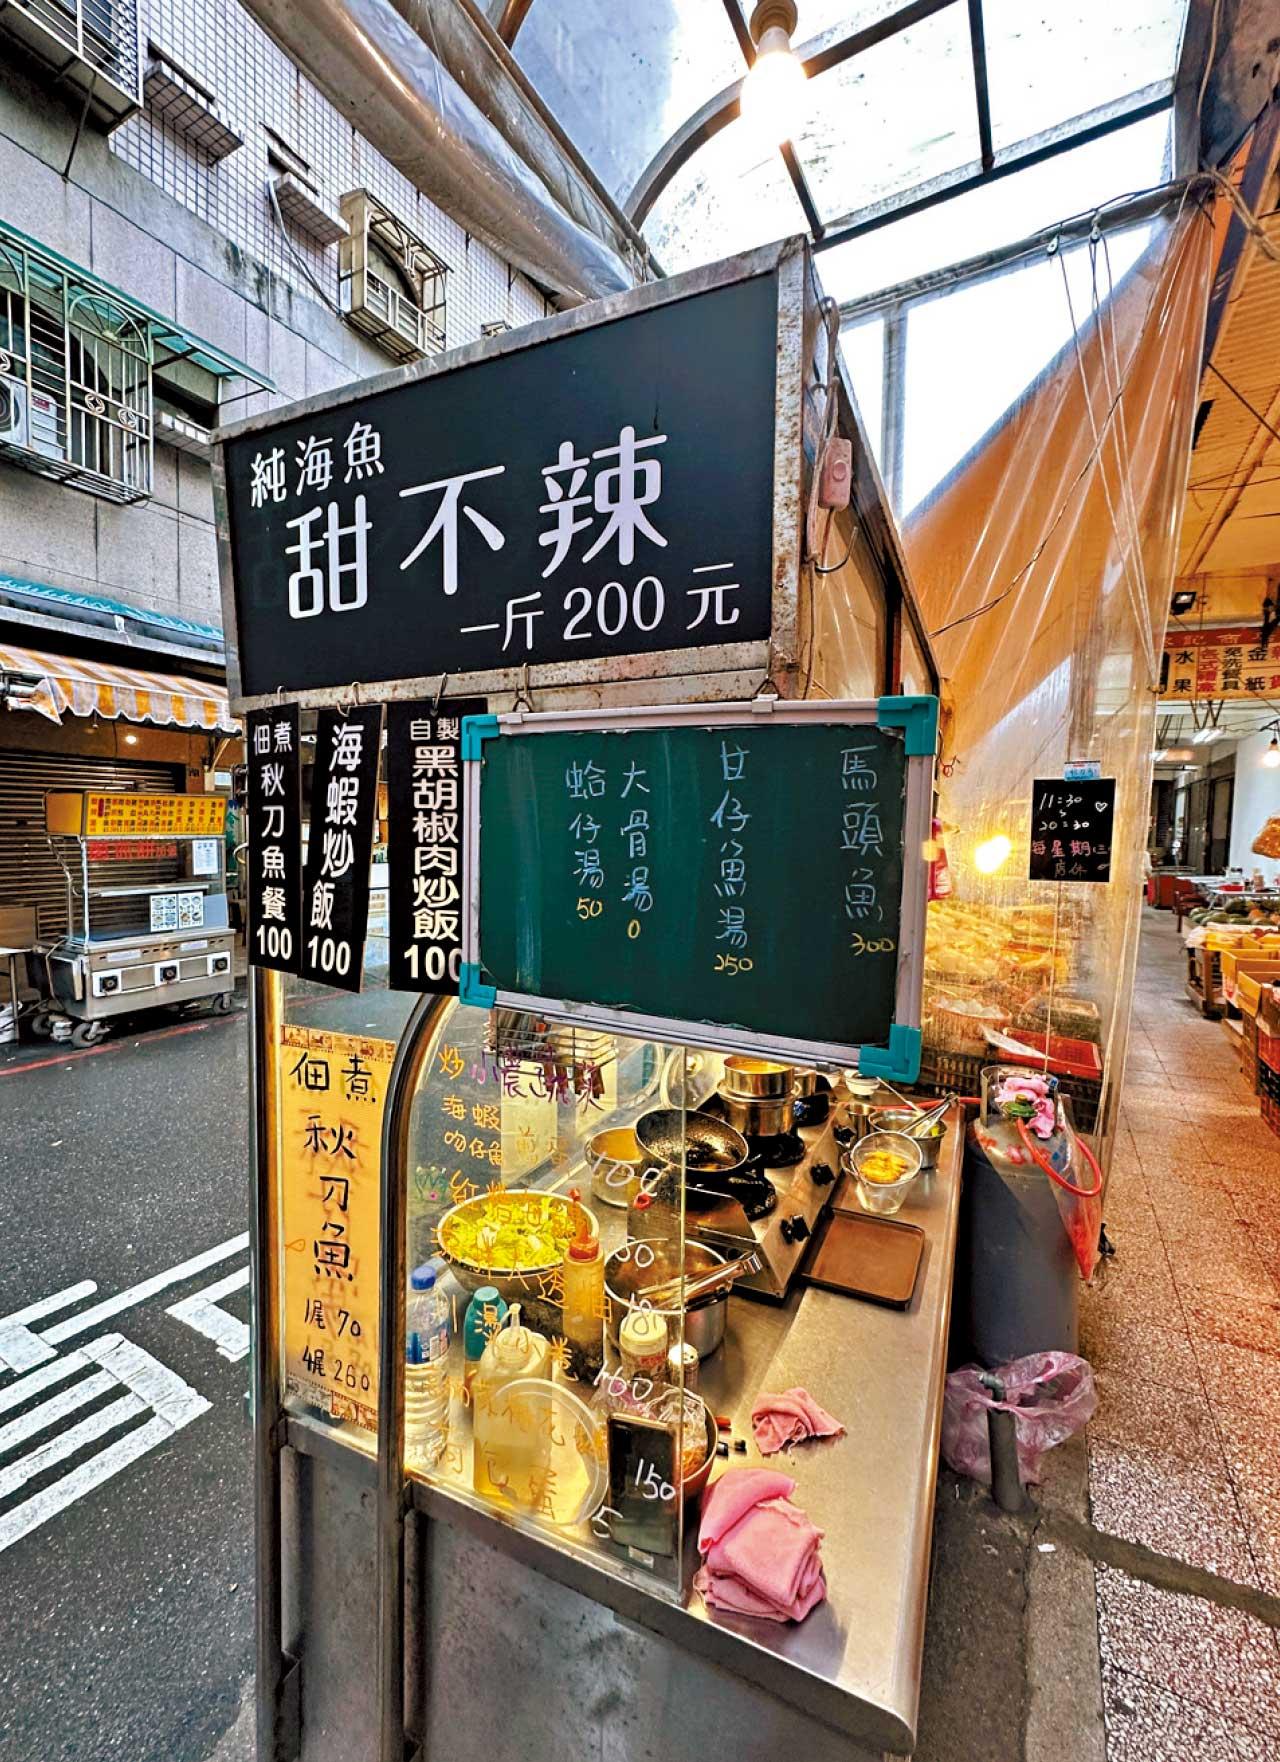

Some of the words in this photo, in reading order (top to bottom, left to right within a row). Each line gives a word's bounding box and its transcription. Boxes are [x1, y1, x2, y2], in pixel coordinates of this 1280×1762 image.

[250, 421, 385, 508] 純海魚
[285, 425, 668, 620] 甜不辣
[253, 721, 293, 756] 佃煮
[410, 717, 460, 742] 自製
[260, 762, 286, 922] 秋刀魚餐
[310, 723, 364, 931] 海蝦炒飯
[412, 745, 460, 942] 黑胡椒肉炒飯
[620, 760, 654, 912] 大骨湯
[839, 745, 884, 922] 馬頭魚
[576, 897, 603, 920] 50
[256, 924, 293, 960] 100
[308, 935, 351, 976] 100
[851, 933, 896, 956] 300
[714, 953, 753, 976] 250
[289, 1052, 376, 1103] 佃煮
[303, 1114, 357, 1282] 秋刀魚
[337, 1309, 361, 1337] 70
[334, 1359, 370, 1392] 260
[634, 1458, 677, 1501] 150
